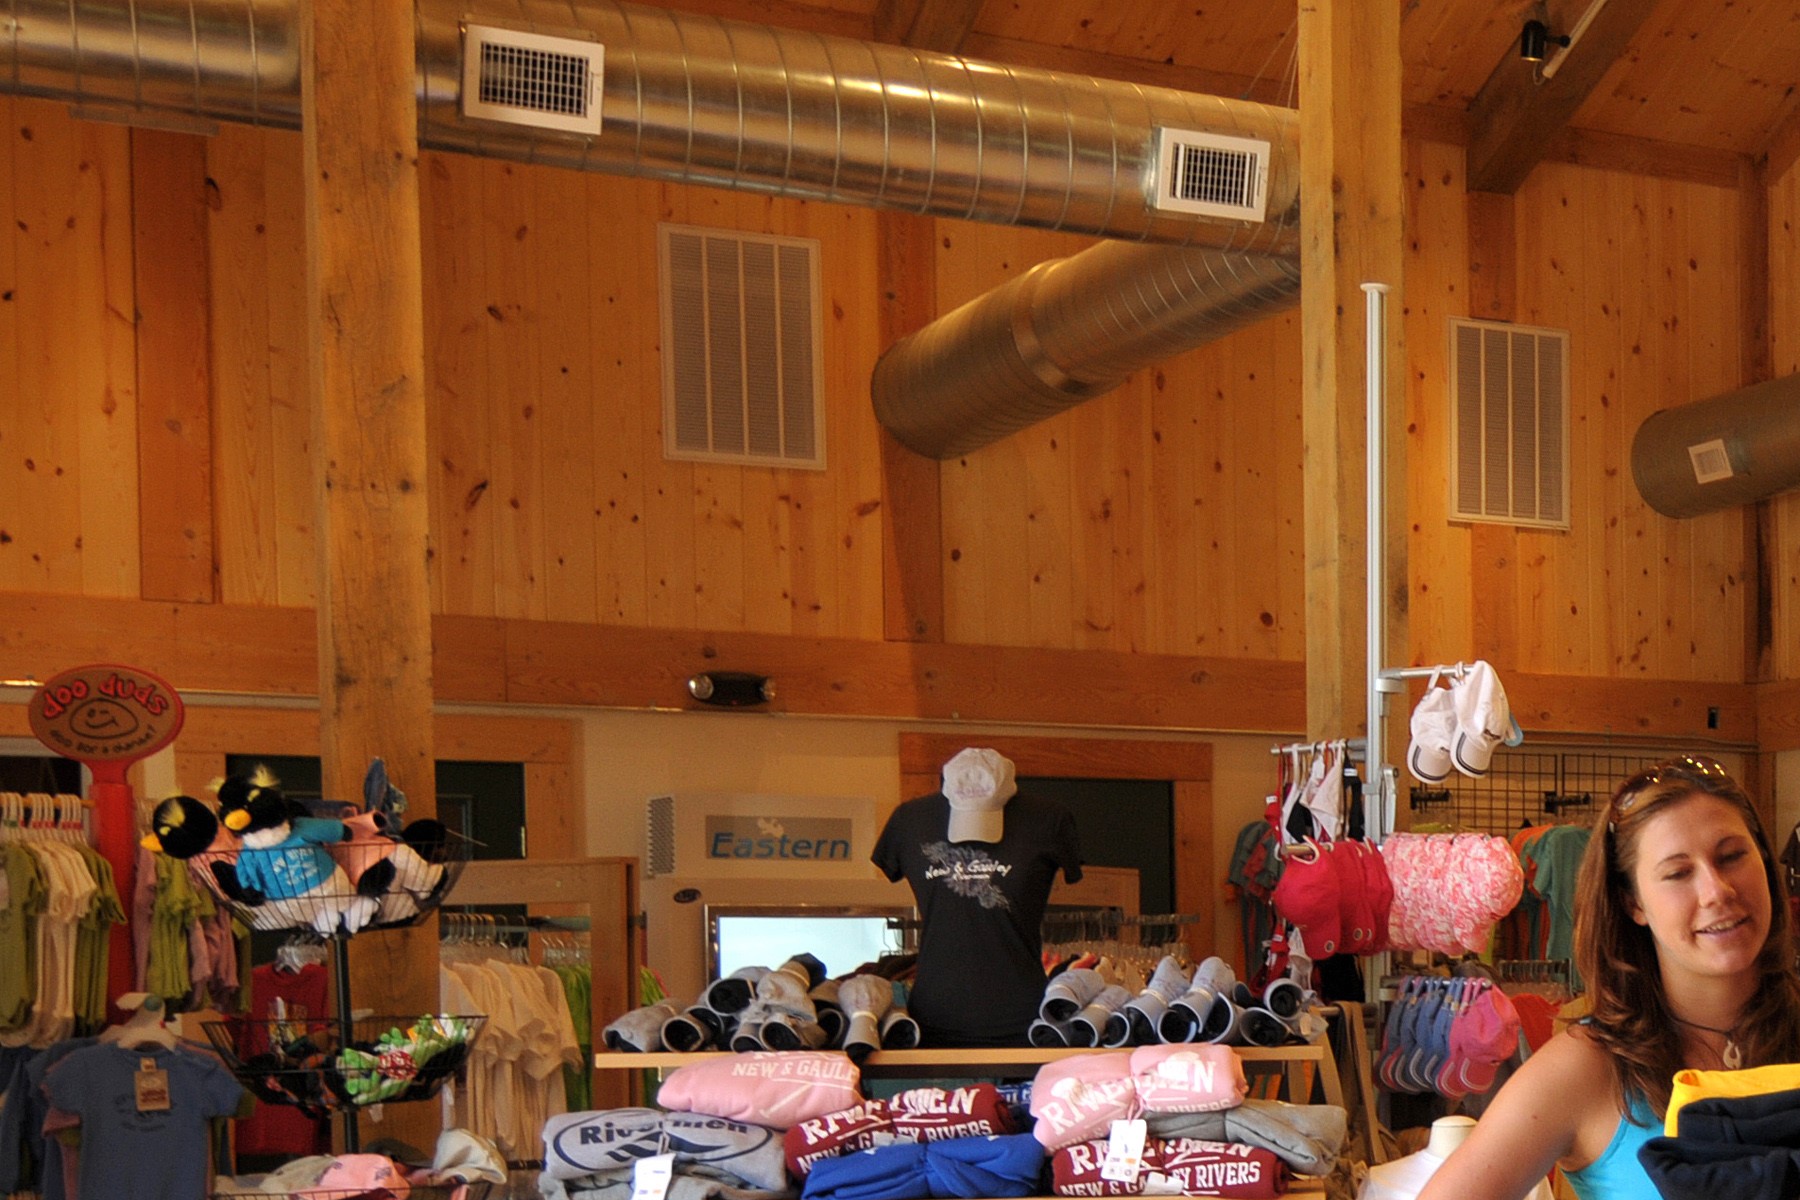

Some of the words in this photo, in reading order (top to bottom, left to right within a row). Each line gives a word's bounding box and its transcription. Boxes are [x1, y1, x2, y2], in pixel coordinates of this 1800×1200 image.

[98, 672, 170, 716] duds
[710, 831, 851, 861] Eastern
[731, 1060, 777, 1078] NEW
[779, 1059, 792, 1075] &
[923, 1119, 994, 1144] RIVERS
[1059, 1180, 1106, 1198] NEW
[1109, 1180, 1121, 1195] &
[1194, 1161, 1262, 1189] RIVERS
